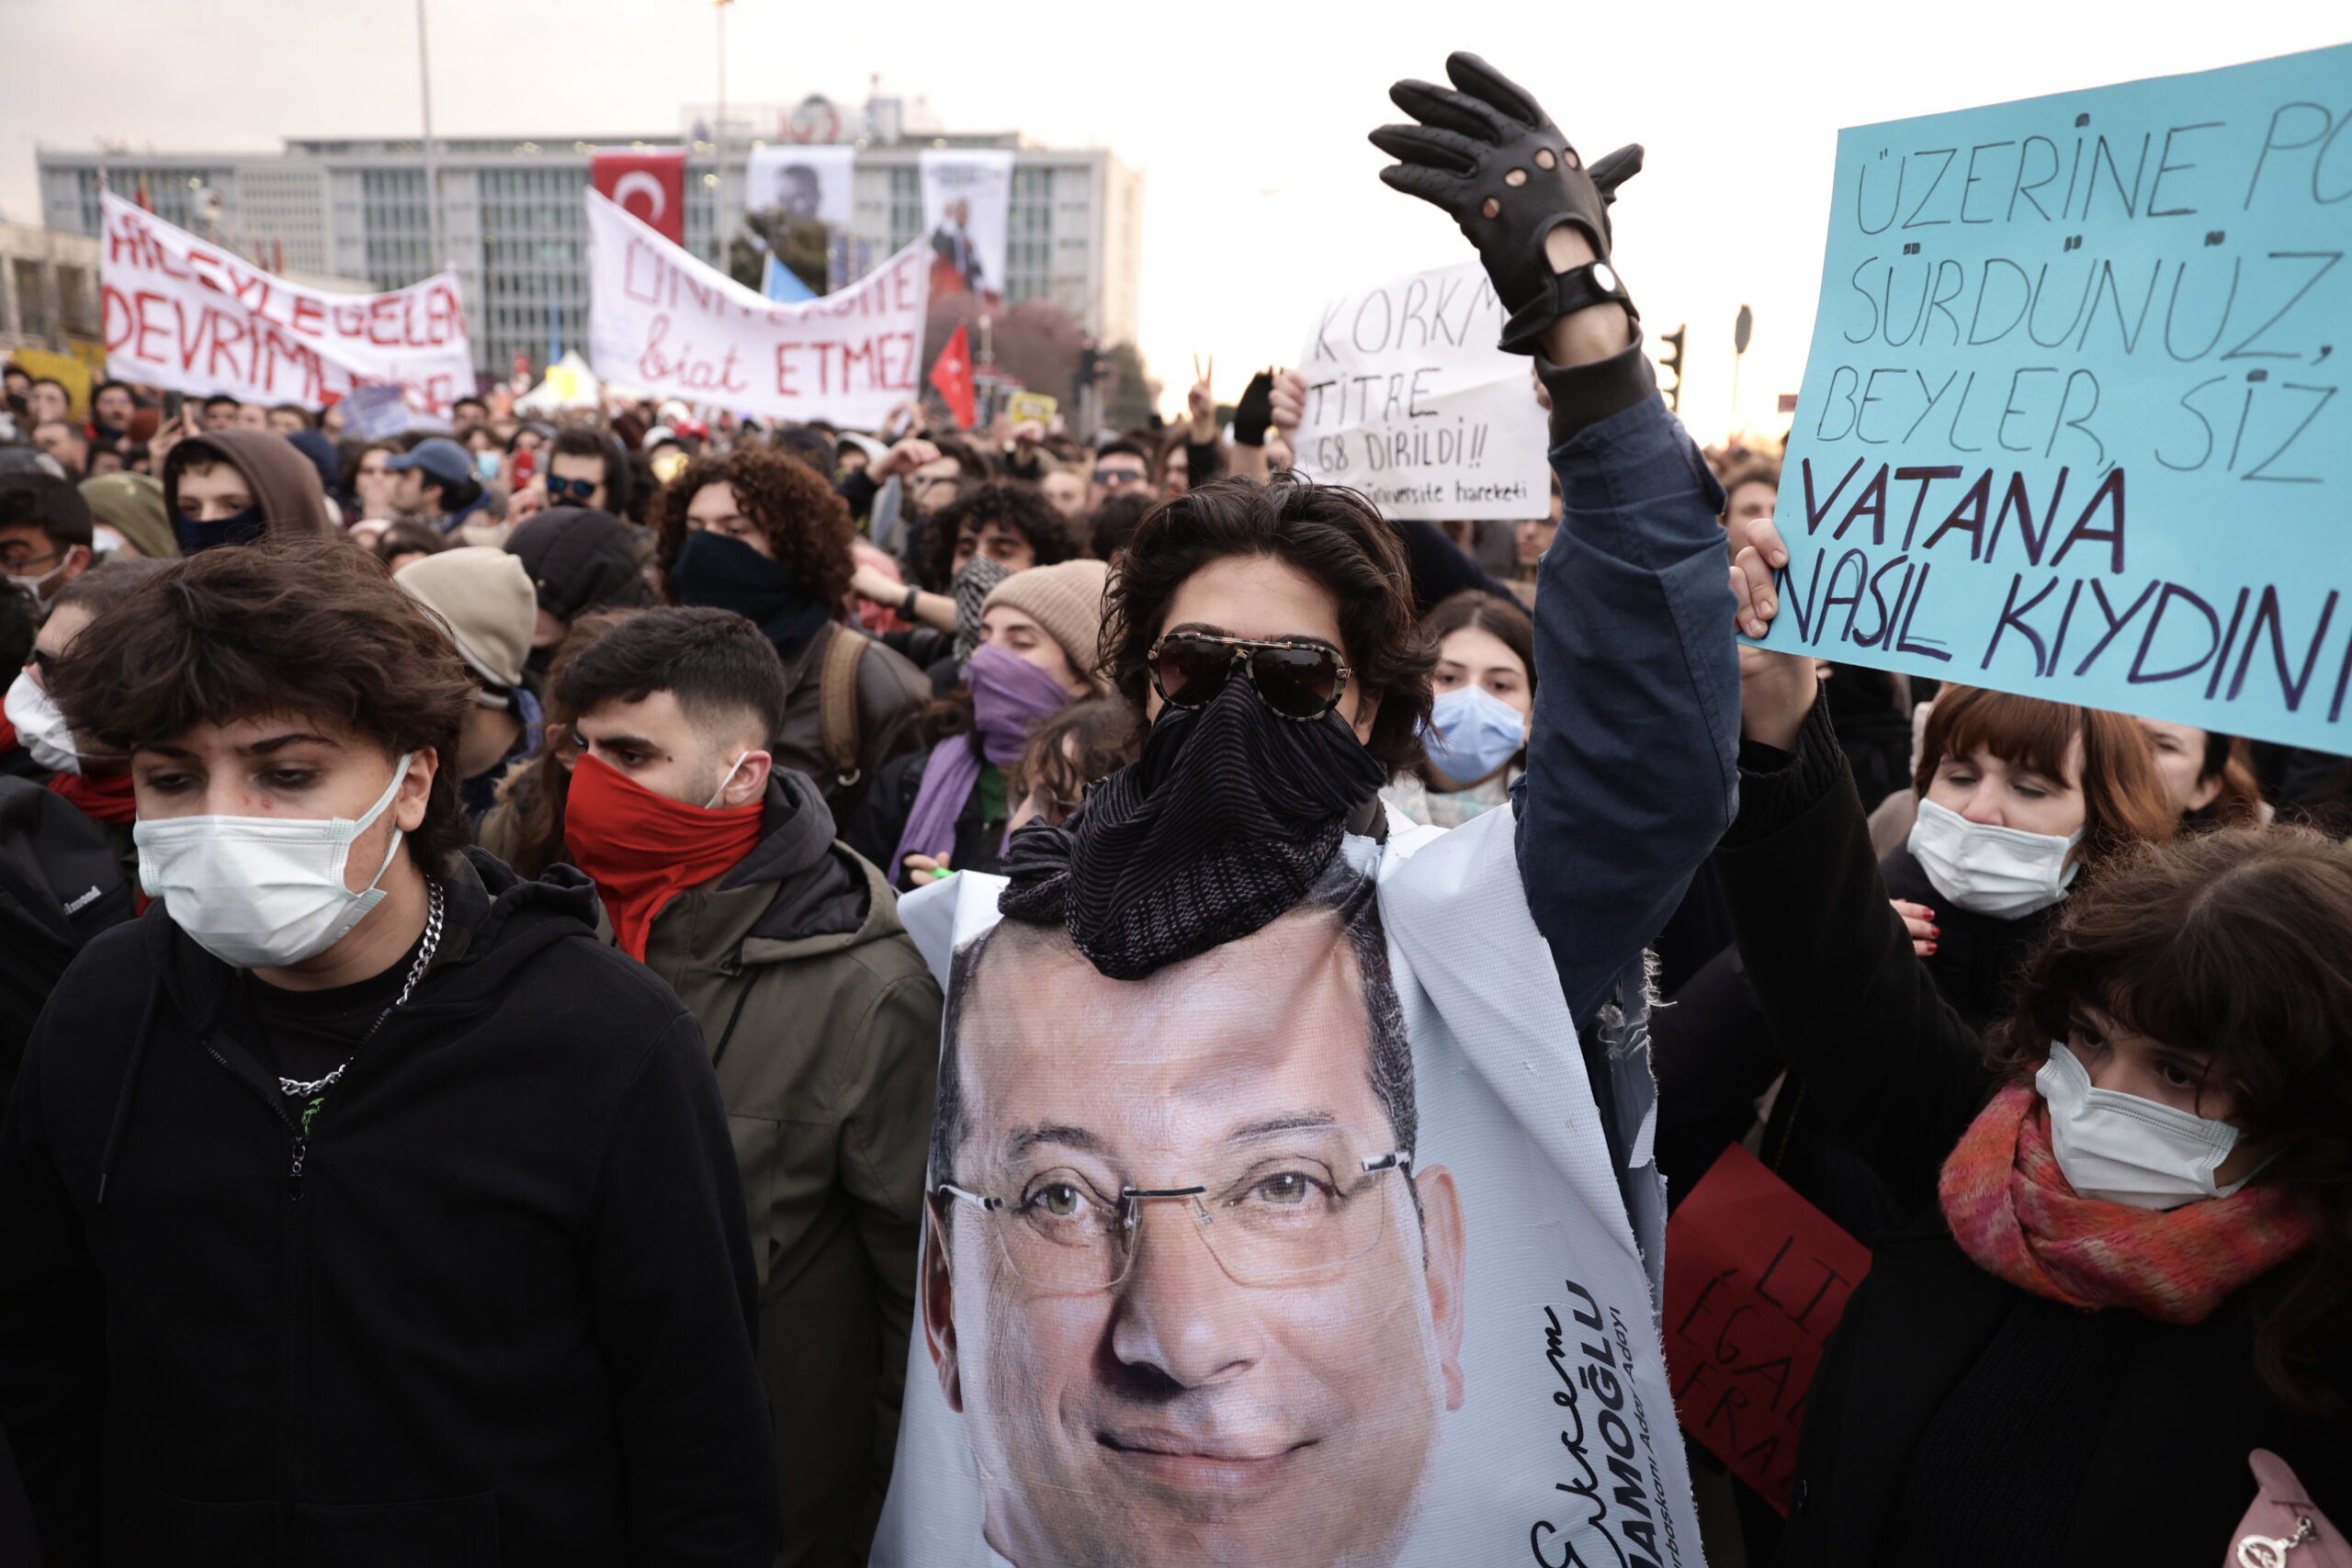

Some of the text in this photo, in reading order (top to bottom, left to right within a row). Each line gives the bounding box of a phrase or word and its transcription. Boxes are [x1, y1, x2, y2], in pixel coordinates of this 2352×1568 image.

[1857, 113, 2227, 235] ÜZERİNE
[1843, 230, 2345, 366] SÜRDÜNÜZ,
[775, 331, 919, 397] ETMEZ
[1310, 367, 1442, 426] TİTRE
[2154, 368, 2339, 484] SİZ
[1802, 457, 2125, 575] VATANA
[1761, 547, 1953, 663] NASIL
[1565, 1280, 1663, 1568] AMOĞLU
[1673, 1359, 1792, 1489] FRA
